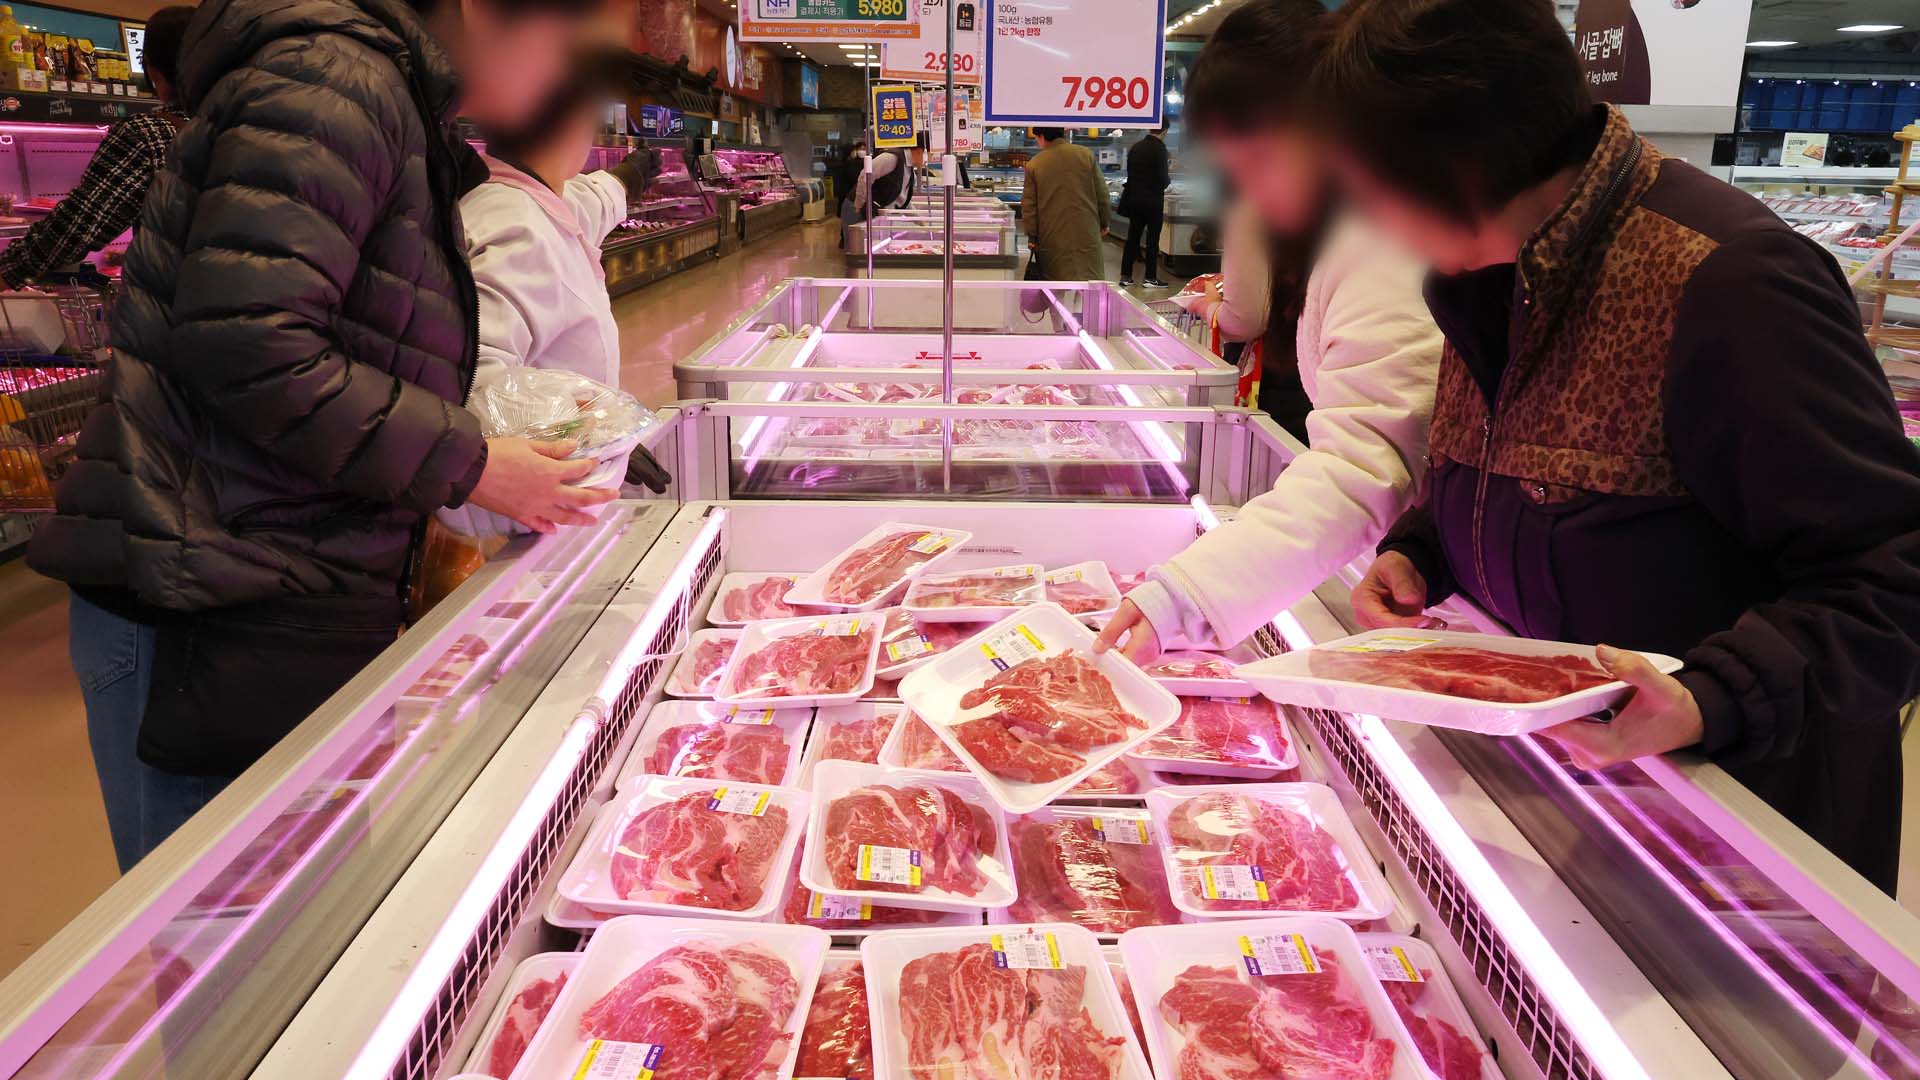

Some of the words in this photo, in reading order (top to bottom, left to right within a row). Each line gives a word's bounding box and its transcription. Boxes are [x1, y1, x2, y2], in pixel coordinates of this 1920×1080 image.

[858, 0, 903, 16] 5,980
[998, 4, 1017, 15] 100g
[998, 16, 1019, 25] 국내산
[1602, 69, 1618, 83] bone
[1062, 76, 1149, 111] 7,980
